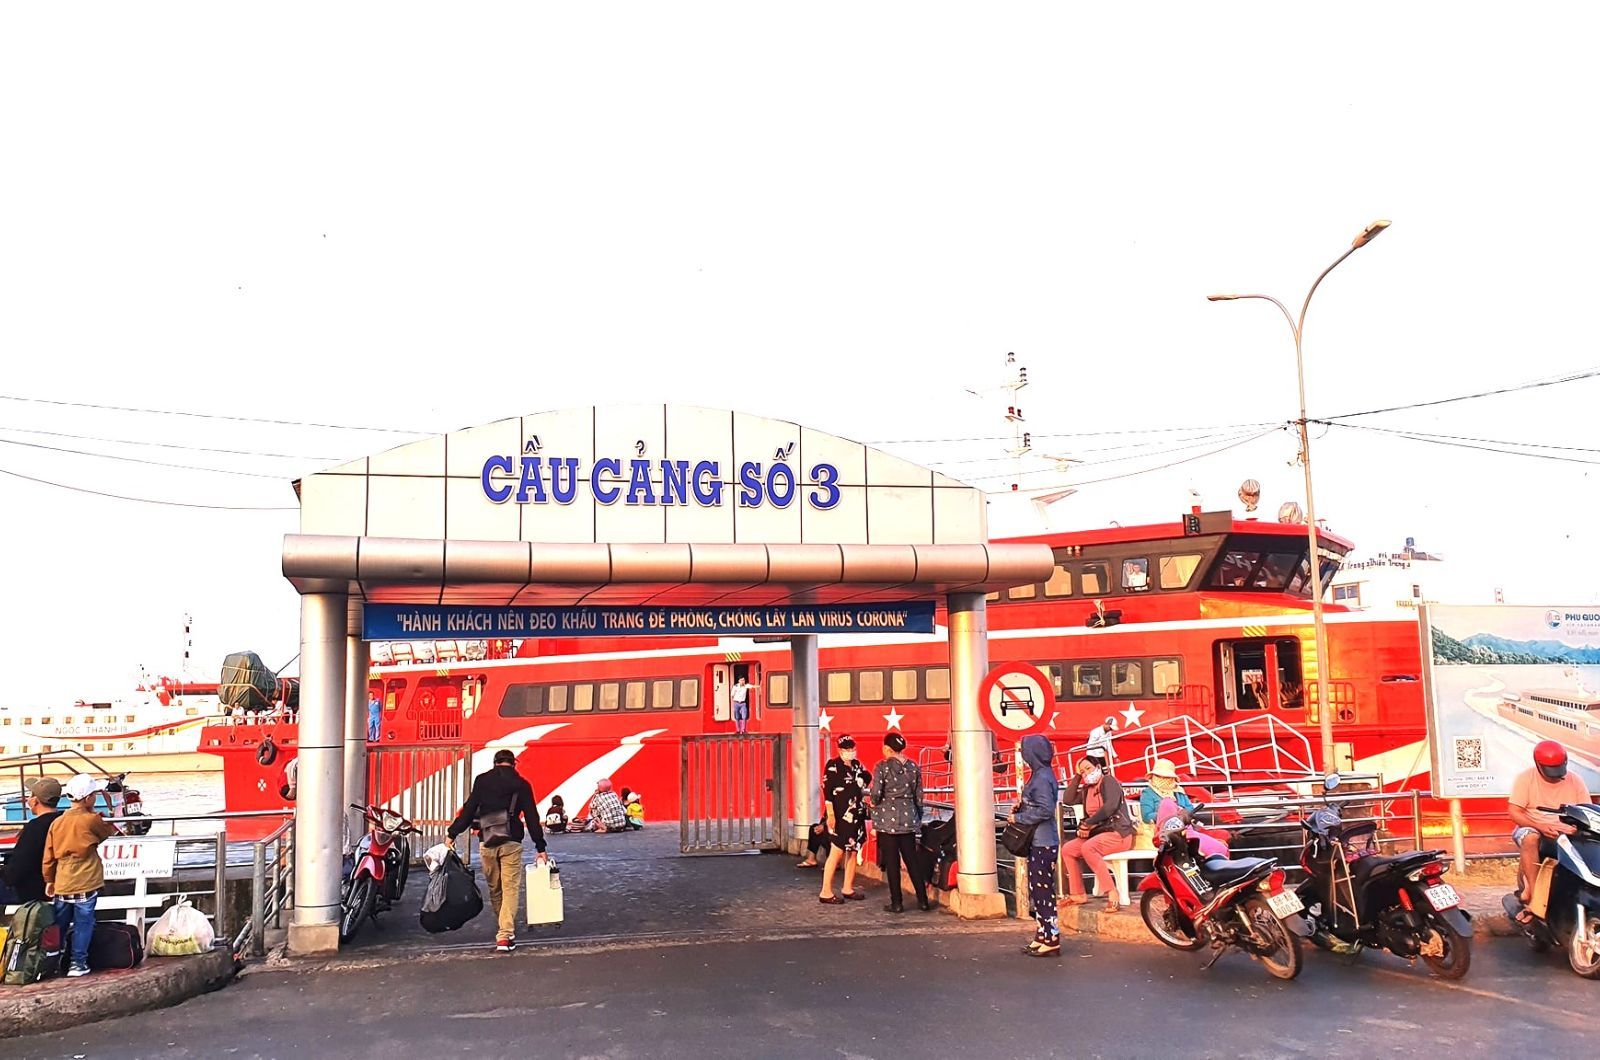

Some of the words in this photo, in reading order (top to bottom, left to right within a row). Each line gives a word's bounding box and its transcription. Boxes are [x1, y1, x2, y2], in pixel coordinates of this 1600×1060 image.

[482, 434, 579, 504] CẦU
[591, 439, 723, 505] CẢNG
[740, 442, 795, 507] SỐ
[810, 463, 840, 508] 3
[447, 610, 492, 631] KHÁCH
[498, 609, 524, 630] NÊN
[529, 612, 557, 630] ĐEO
[602, 611, 644, 629] TRANG
[719, 607, 762, 628] CHỐNG
[766, 608, 787, 627] LÂY
[792, 611, 815, 627] LAN
[818, 611, 853, 627] VIRUS
